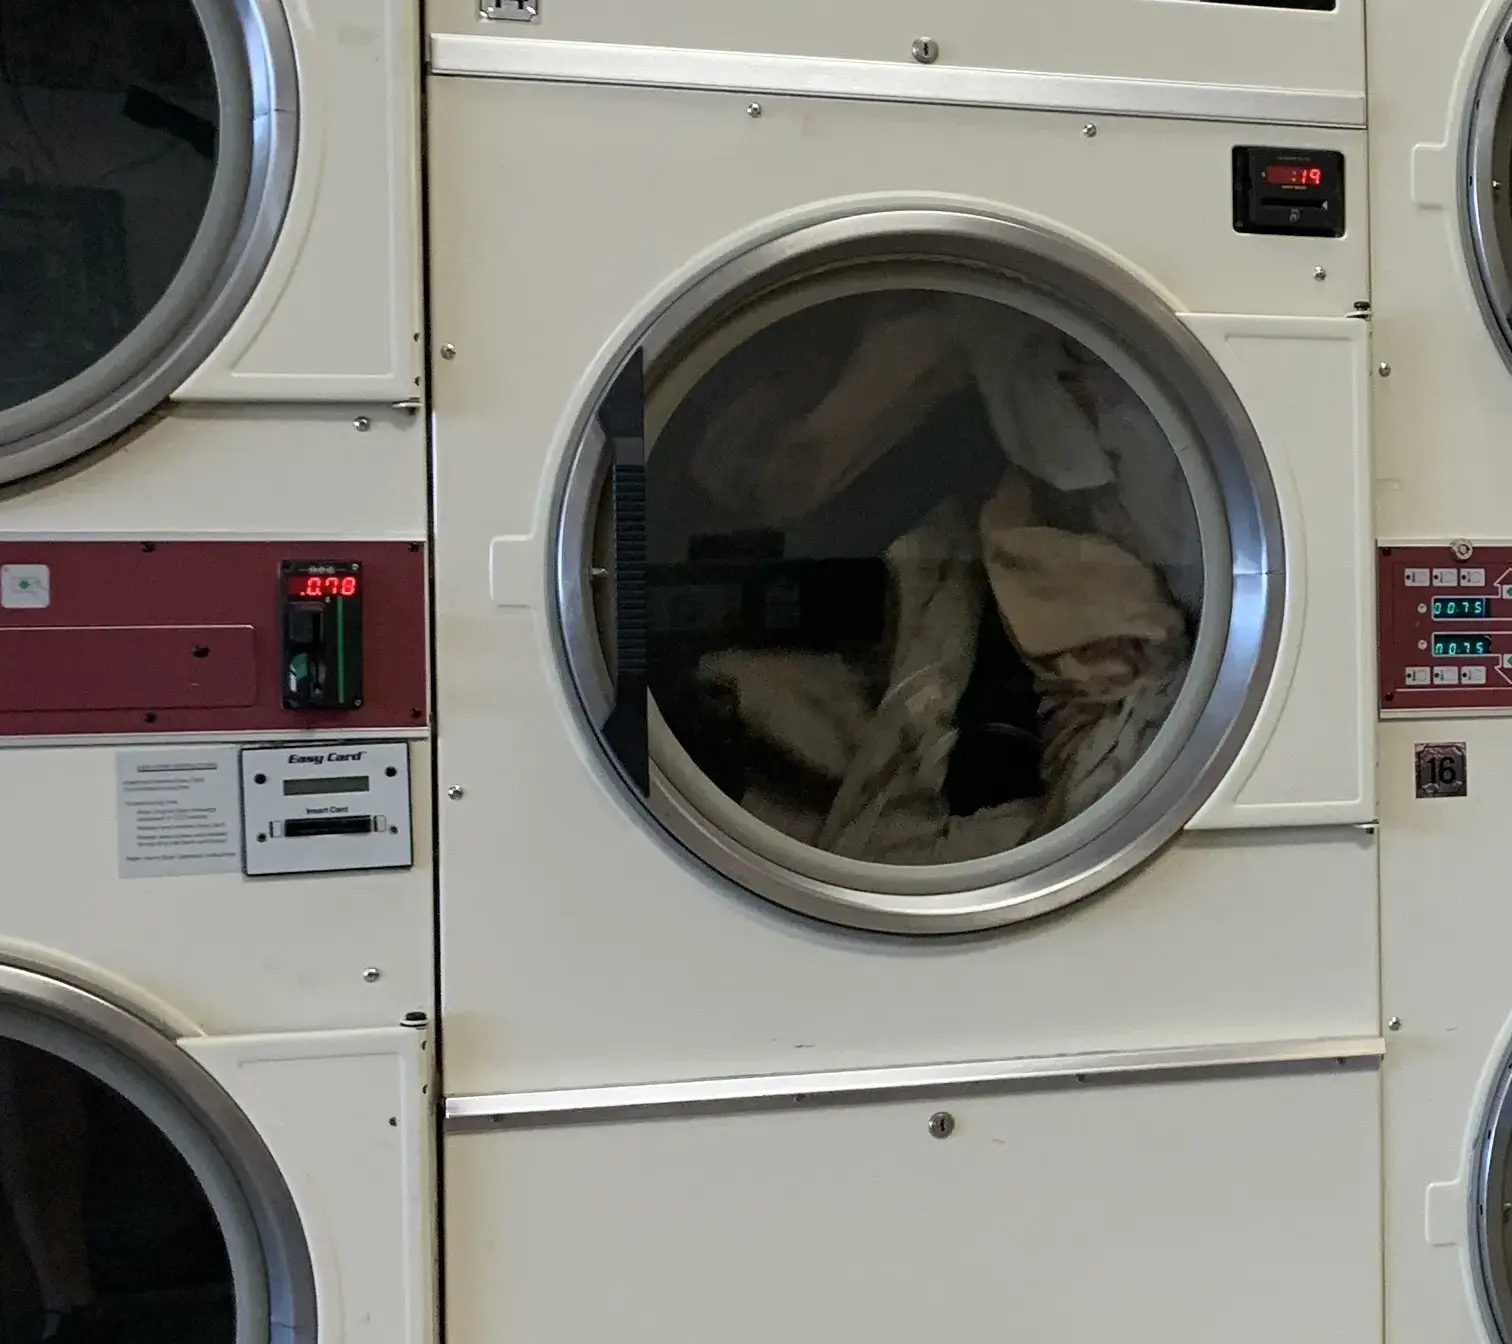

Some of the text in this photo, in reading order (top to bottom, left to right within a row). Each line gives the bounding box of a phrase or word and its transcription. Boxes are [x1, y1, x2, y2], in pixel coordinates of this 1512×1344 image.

[288, 751, 363, 765] Easy Card
[1426, 756, 1456, 785] 16
